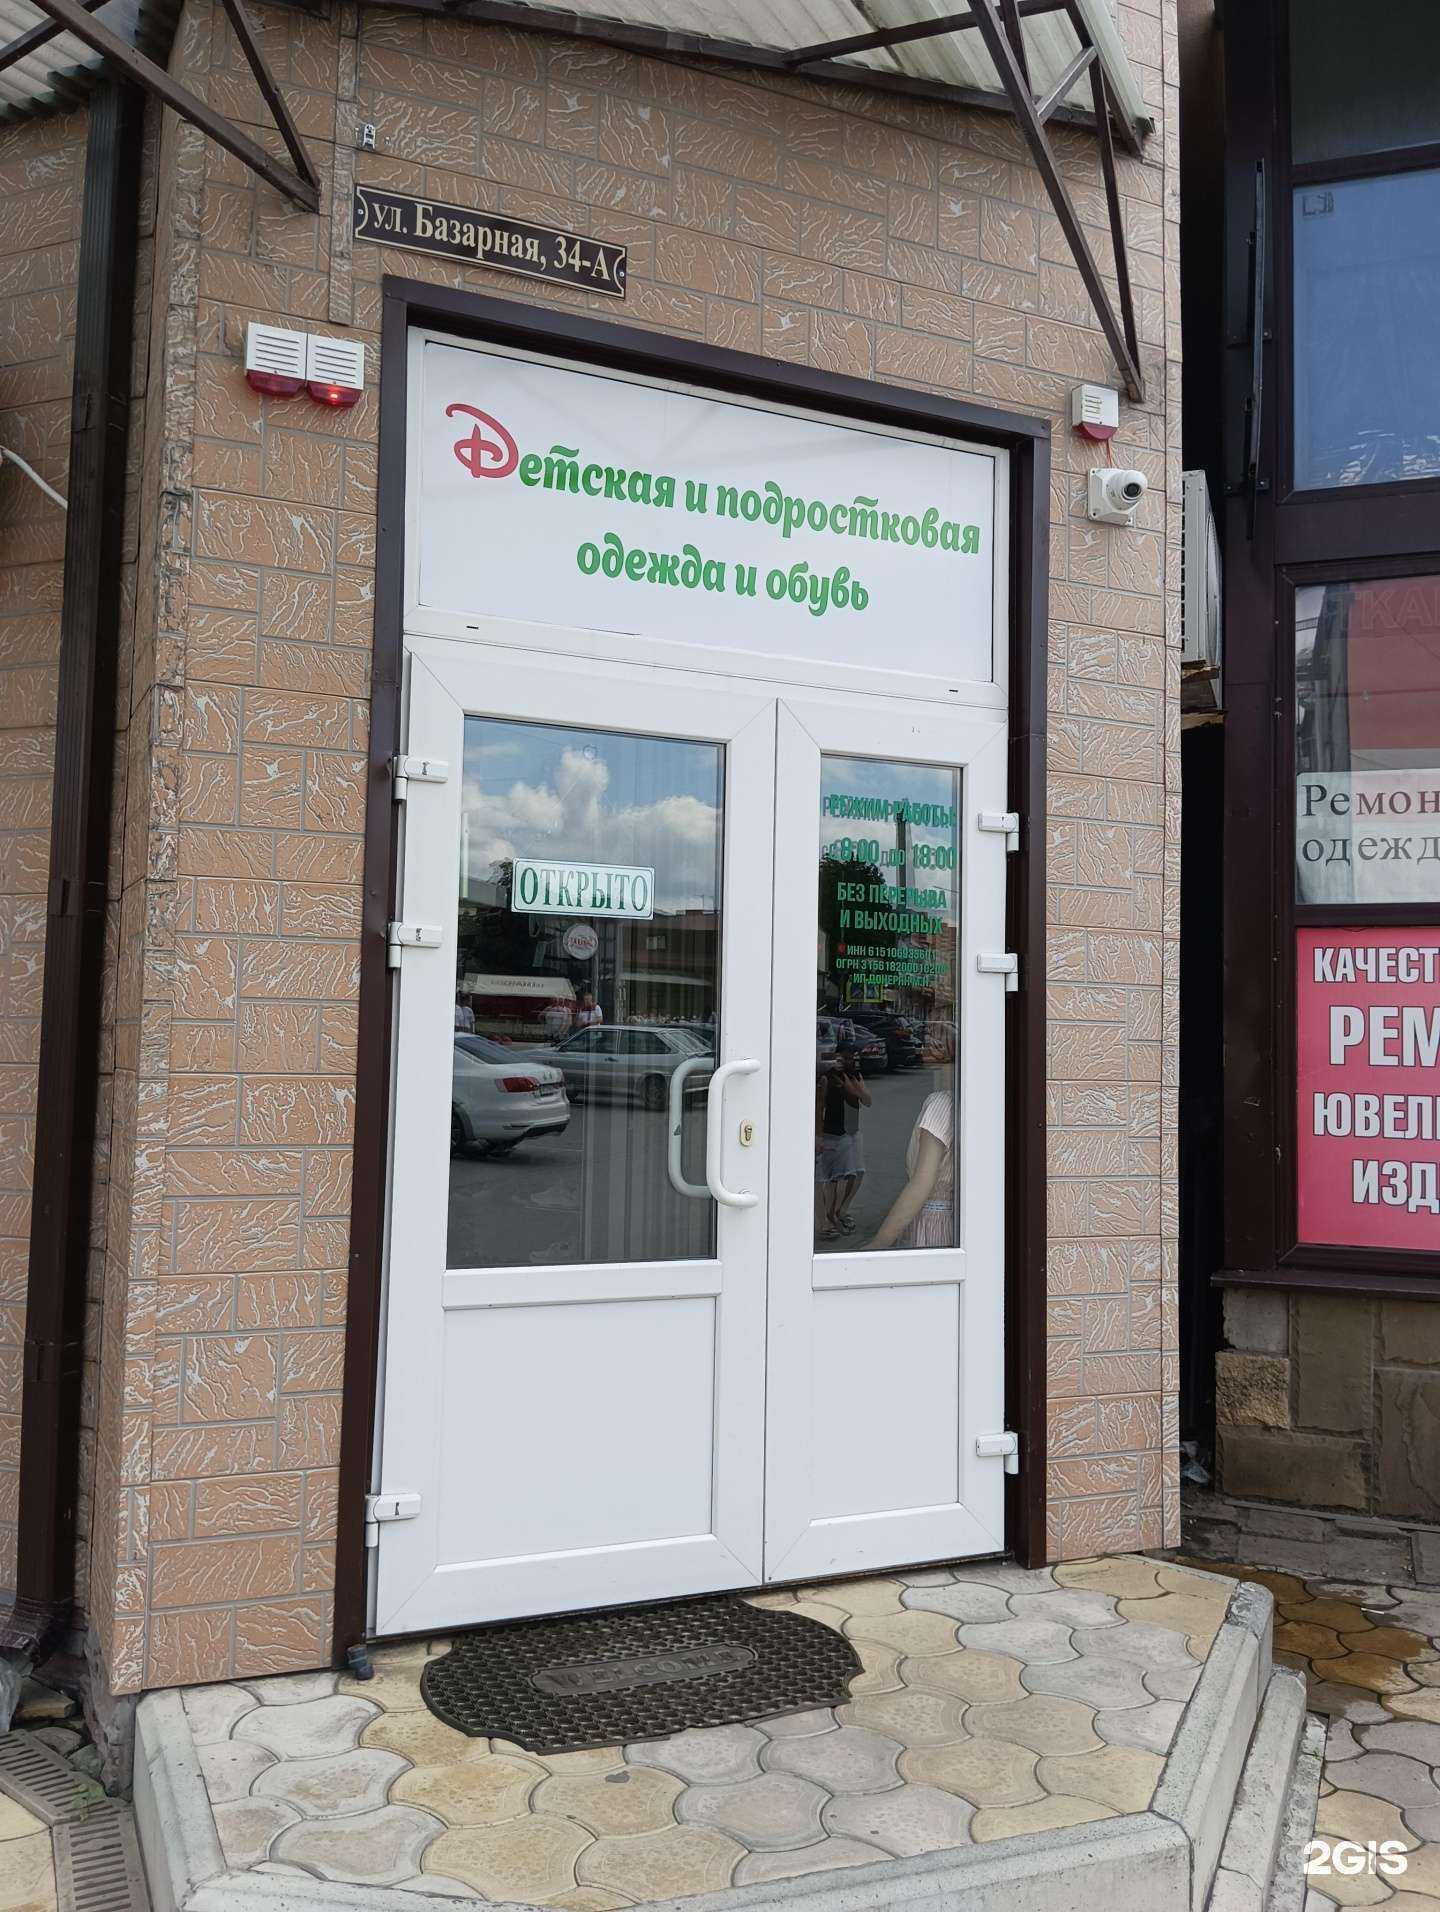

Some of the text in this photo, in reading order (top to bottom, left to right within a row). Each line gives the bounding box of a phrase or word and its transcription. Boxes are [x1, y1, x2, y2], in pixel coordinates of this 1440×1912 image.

[372, 203, 611, 281] ул. Базарная, 34-А
[445, 403, 981, 555] Детская и подростковая
[576, 532, 869, 617] одежда и обувь
[824, 793, 957, 829] РЕЖИМ РАБОТЫ
[912, 843, 957, 871] 18:00
[520, 867, 648, 911] ОТКРЫТО
[837, 882, 947, 909] БЕЗ ПЕРЕРЫВА
[840, 909, 943, 935] И ВЫХОДНЫХ
[835, 958, 859, 970] ОГРН
[847, 945, 866, 957] ИНН
[1313, 1091, 1440, 1140] ЮВЕЛ
